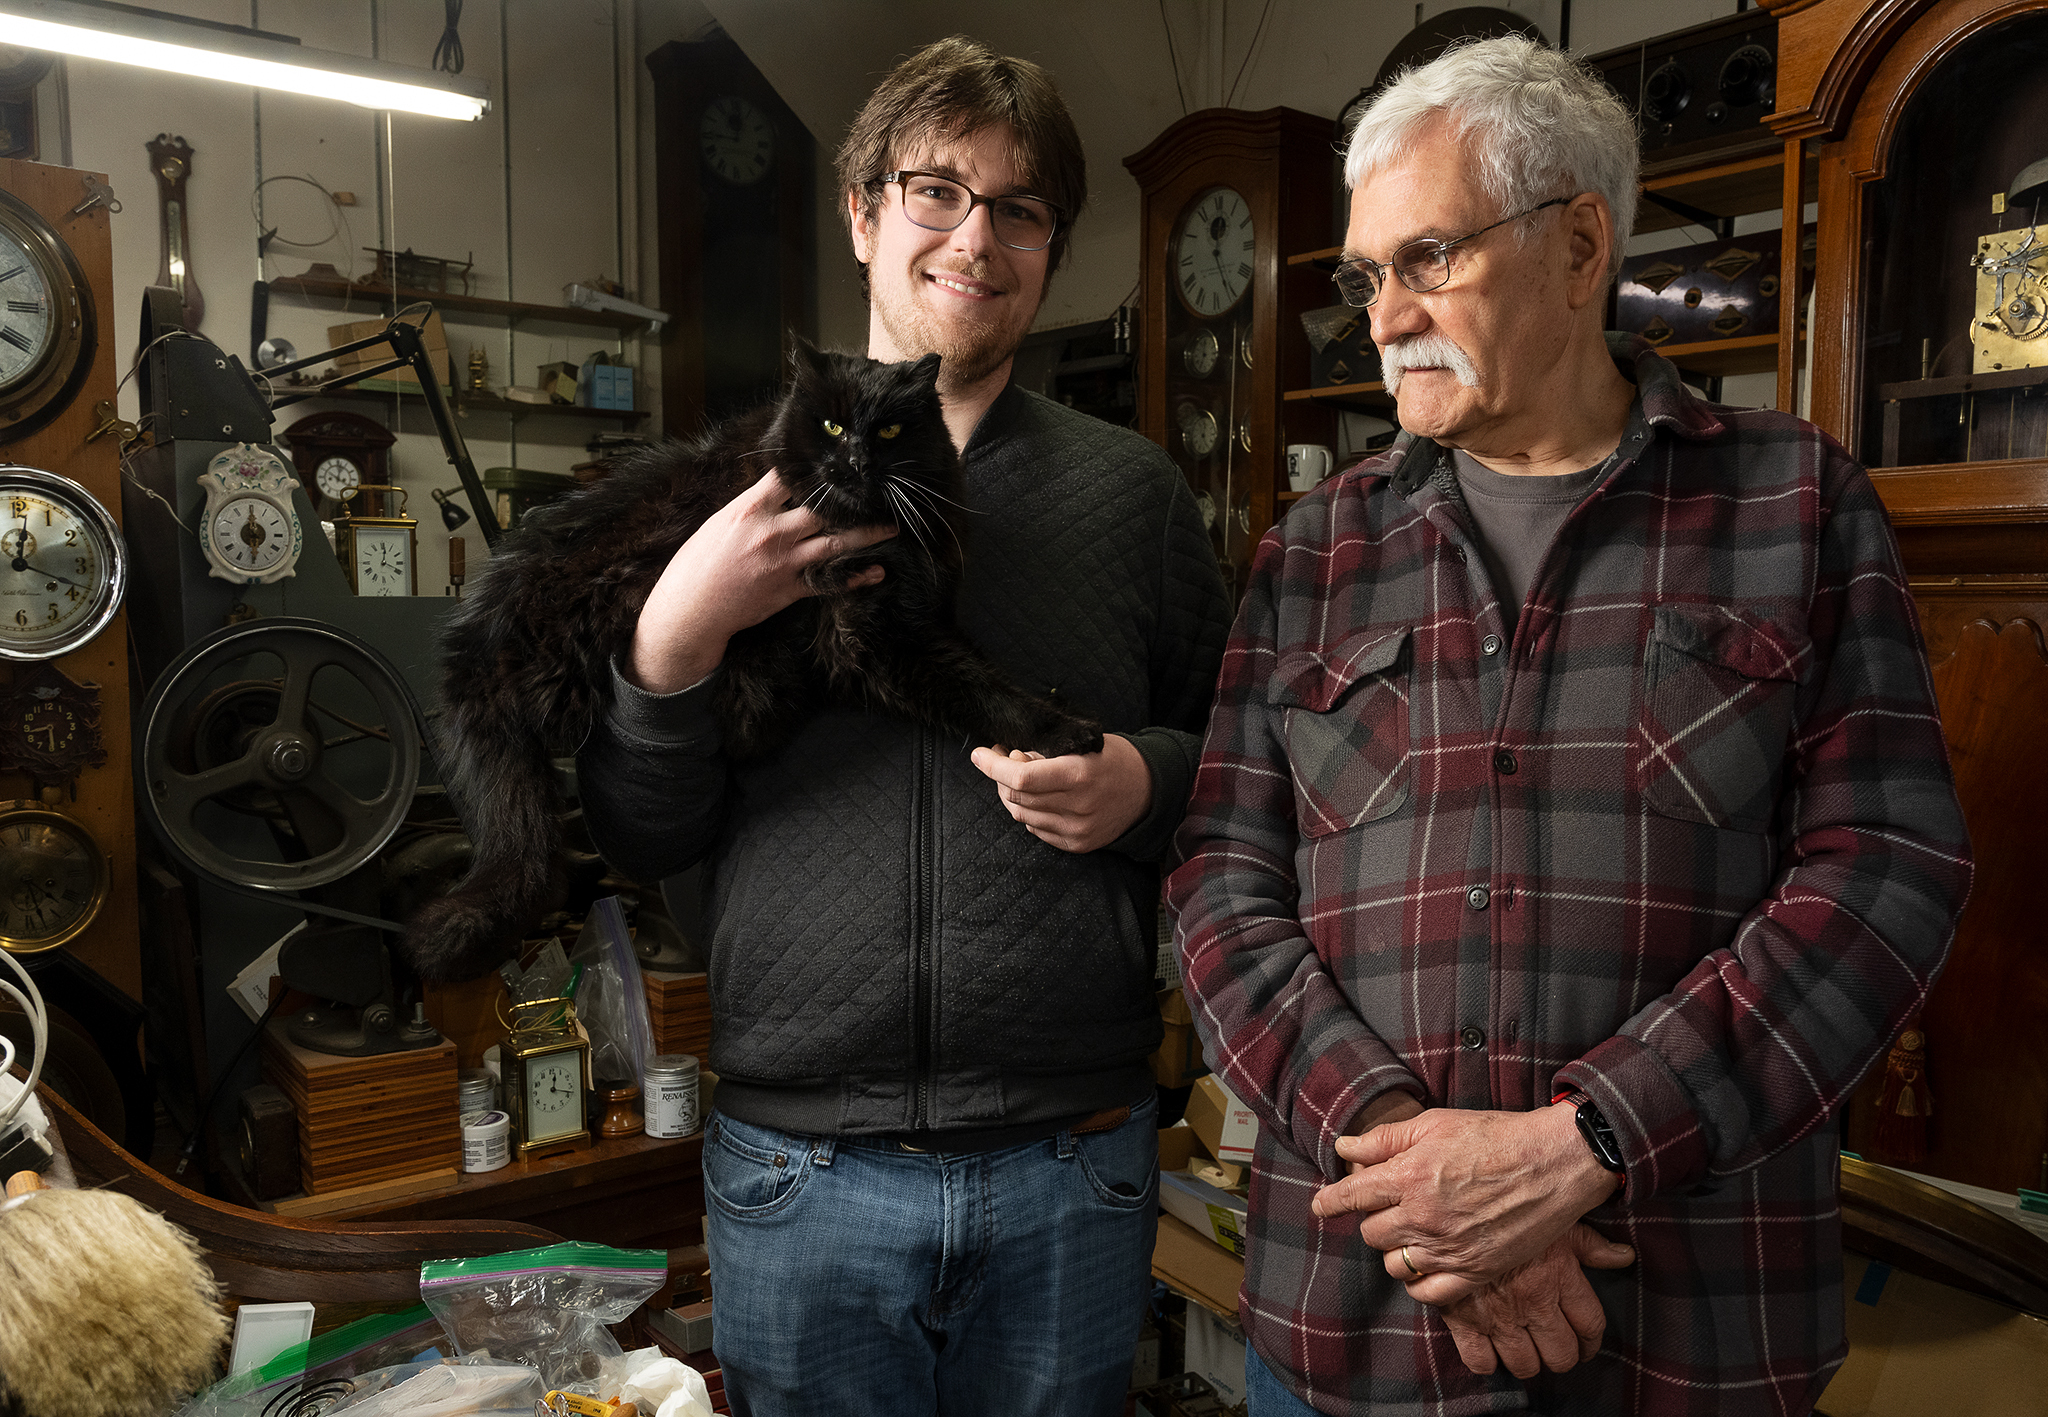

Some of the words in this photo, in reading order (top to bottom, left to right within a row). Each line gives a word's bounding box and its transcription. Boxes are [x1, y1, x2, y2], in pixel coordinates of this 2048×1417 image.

[7, 300, 39, 314] III
[11, 501, 27, 518] 12
[45, 510, 52, 526] 1
[64, 529, 78, 547] 2
[75, 557, 87, 575] 3
[65, 585, 80, 601] 4
[48, 603, 58, 621] 5
[15, 609, 27, 626] 6
[33, 706, 41, 714] 11
[44, 702, 54, 711] 12
[58, 705, 62, 713] 1
[25, 713, 34, 721] 10
[66, 712, 73, 720] 2
[23, 724, 30, 733] 9
[69, 722, 76, 731] 3
[27, 734, 34, 743] 8
[66, 732, 73, 741] 4
[36, 741, 43, 750] 7
[59, 740, 66, 749] 5
[1233, 1110, 1255, 1119] PRIORITY
[1237, 1118, 1249, 1126] MAIL
